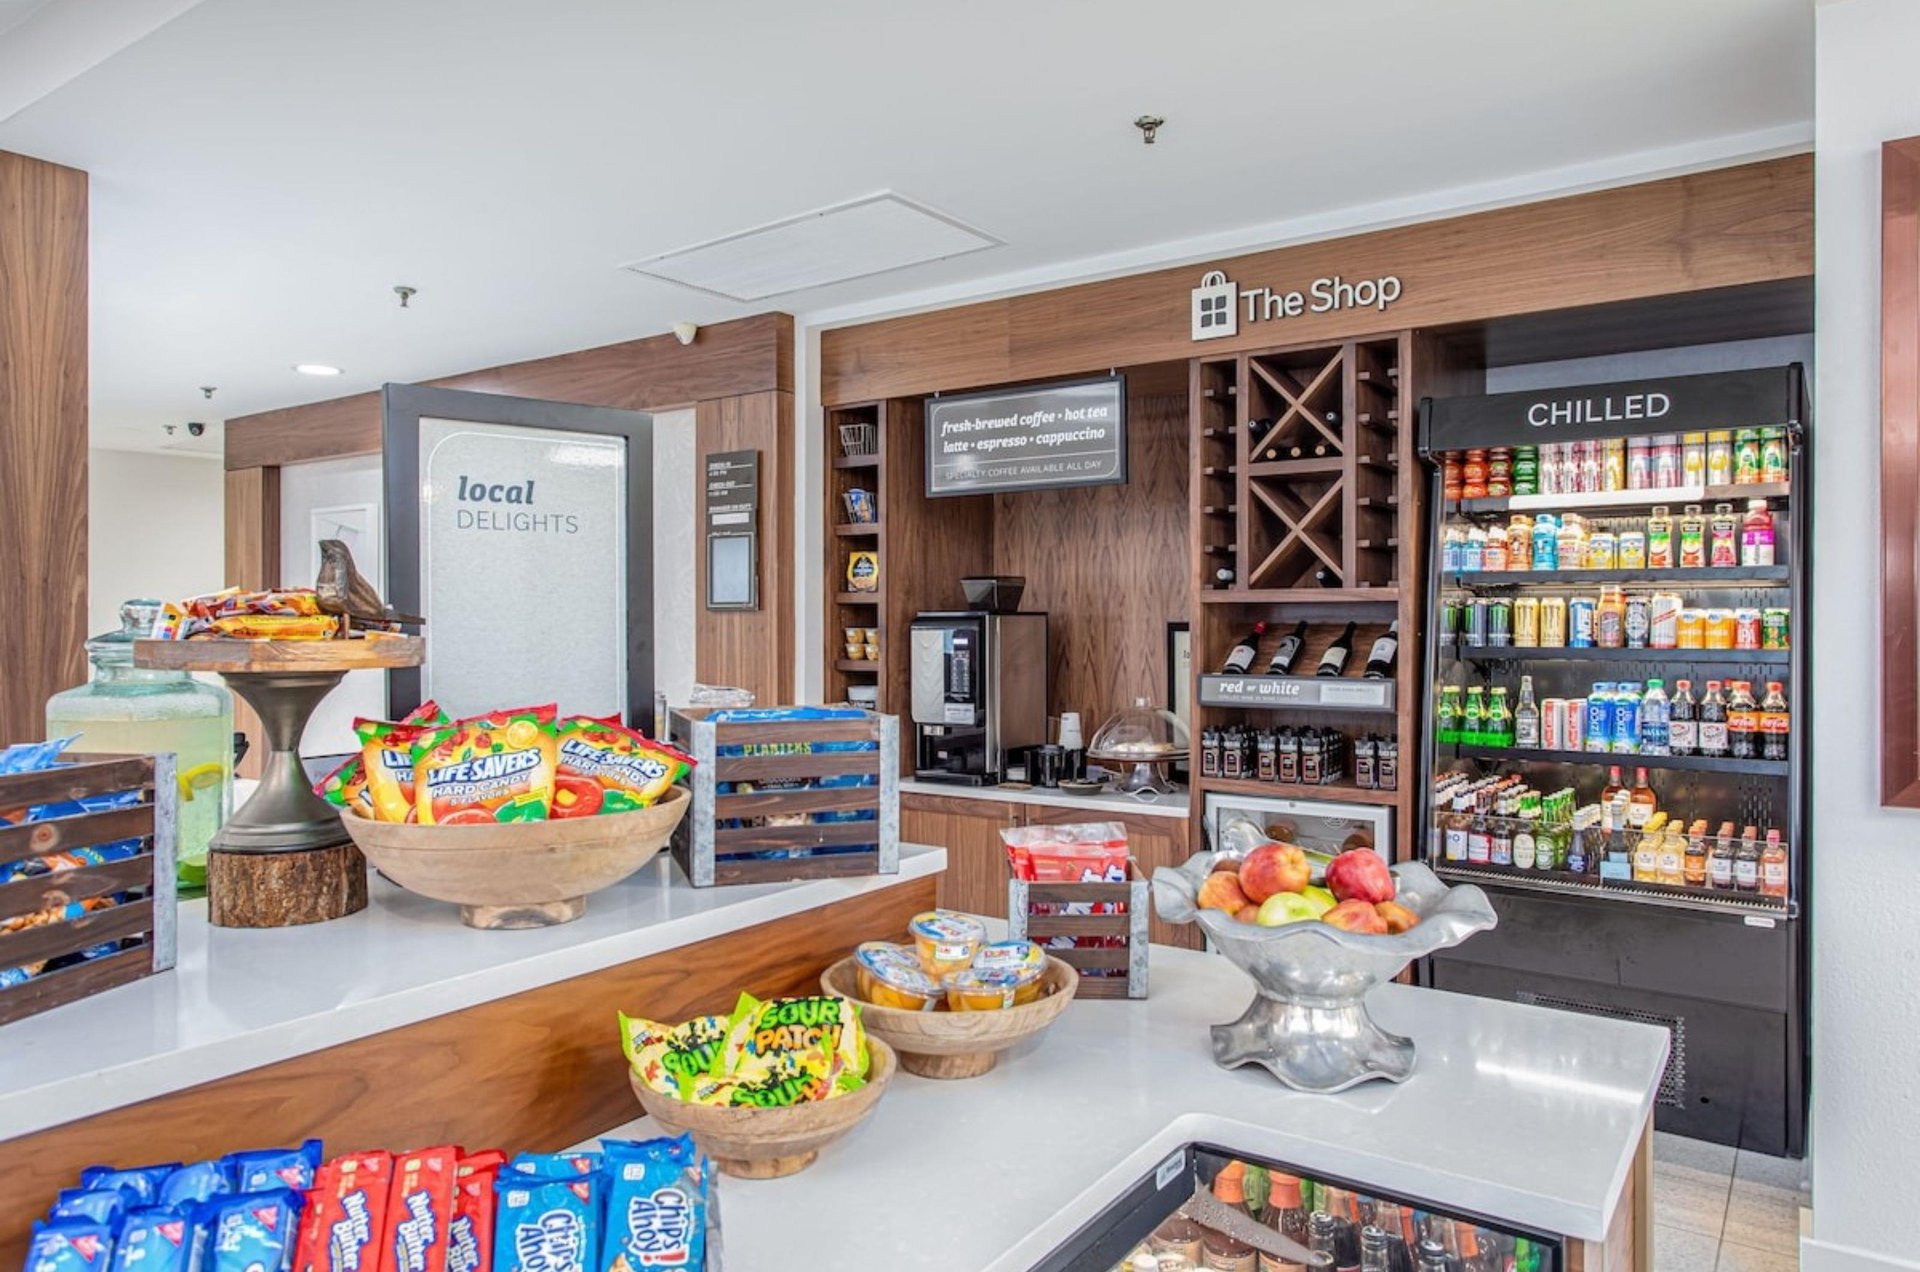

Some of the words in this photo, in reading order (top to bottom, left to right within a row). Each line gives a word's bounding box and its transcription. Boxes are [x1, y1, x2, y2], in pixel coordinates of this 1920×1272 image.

[1240, 287, 1304, 322] The
[1310, 276, 1402, 311] Shop
[940, 414, 1018, 437] fresh-brewed
[1020, 410, 1056, 428] coffee
[1064, 407, 1085, 421] hot
[1086, 405, 1108, 418] tea
[1528, 393, 1670, 426] CHILLED
[943, 440, 969, 454] latte
[976, 437, 1027, 452] espresso
[1036, 426, 1106, 447] cappuccino
[988, 466, 1018, 477] COFFEE
[1020, 463, 1064, 475] AVAILABLE
[1066, 461, 1082, 471] ALL
[1084, 460, 1102, 470] DAY
[457, 475, 535, 505] local
[457, 509, 579, 534] DELIGHTS
[1219, 680, 1243, 694] red
[1259, 681, 1300, 695] white
[427, 761, 470, 786] LIFE
[469, 747, 541, 781] SAVERS
[562, 738, 602, 764] LIFE
[599, 751, 669, 779] SAVERS
[432, 784, 476, 798] HARD
[479, 773, 532, 791] CANDY
[760, 999, 840, 1030] SOUR
[342, 1190, 370, 1243] Nutter
[407, 1190, 435, 1244] Nutter
[654, 1190, 687, 1250] Chips
[332, 1218, 359, 1271] Butter
[398, 1220, 425, 1272] Butter
[451, 1214, 480, 1266] Nutter
